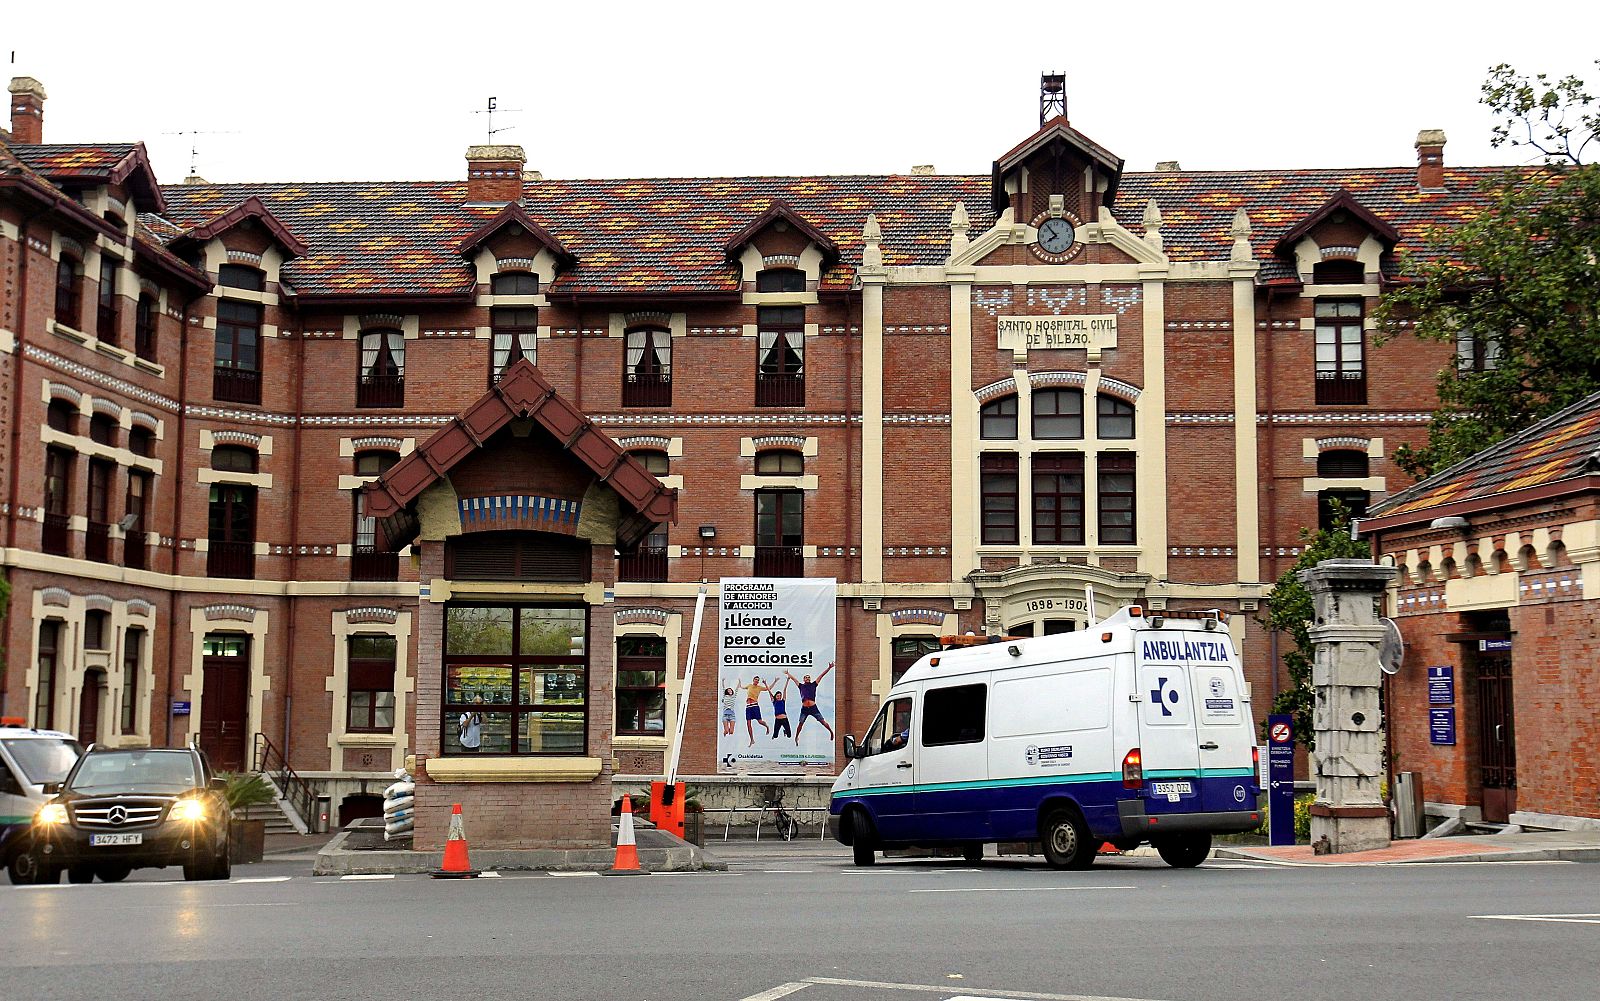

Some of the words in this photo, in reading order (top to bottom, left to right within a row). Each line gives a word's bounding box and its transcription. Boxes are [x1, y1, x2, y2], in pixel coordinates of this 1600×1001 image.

[999, 321, 1031, 330] SANTO
[1036, 320, 1087, 331] HOSPITAL
[1091, 320, 1116, 329] CIVIL
[1027, 334, 1040, 344] DE
[1047, 334, 1091, 344] BILBAO.
[724, 613, 792, 629] ¡Llénate,
[724, 635, 760, 648] pero
[766, 632, 785, 645] de
[1143, 641, 1228, 661] ANBULANTZIA
[724, 651, 813, 664] emociones!
[1157, 784, 1174, 792] 3352
[1177, 784, 1190, 792] DZZ
[96, 835, 118, 844] 3472
[123, 834, 140, 843] HFY
